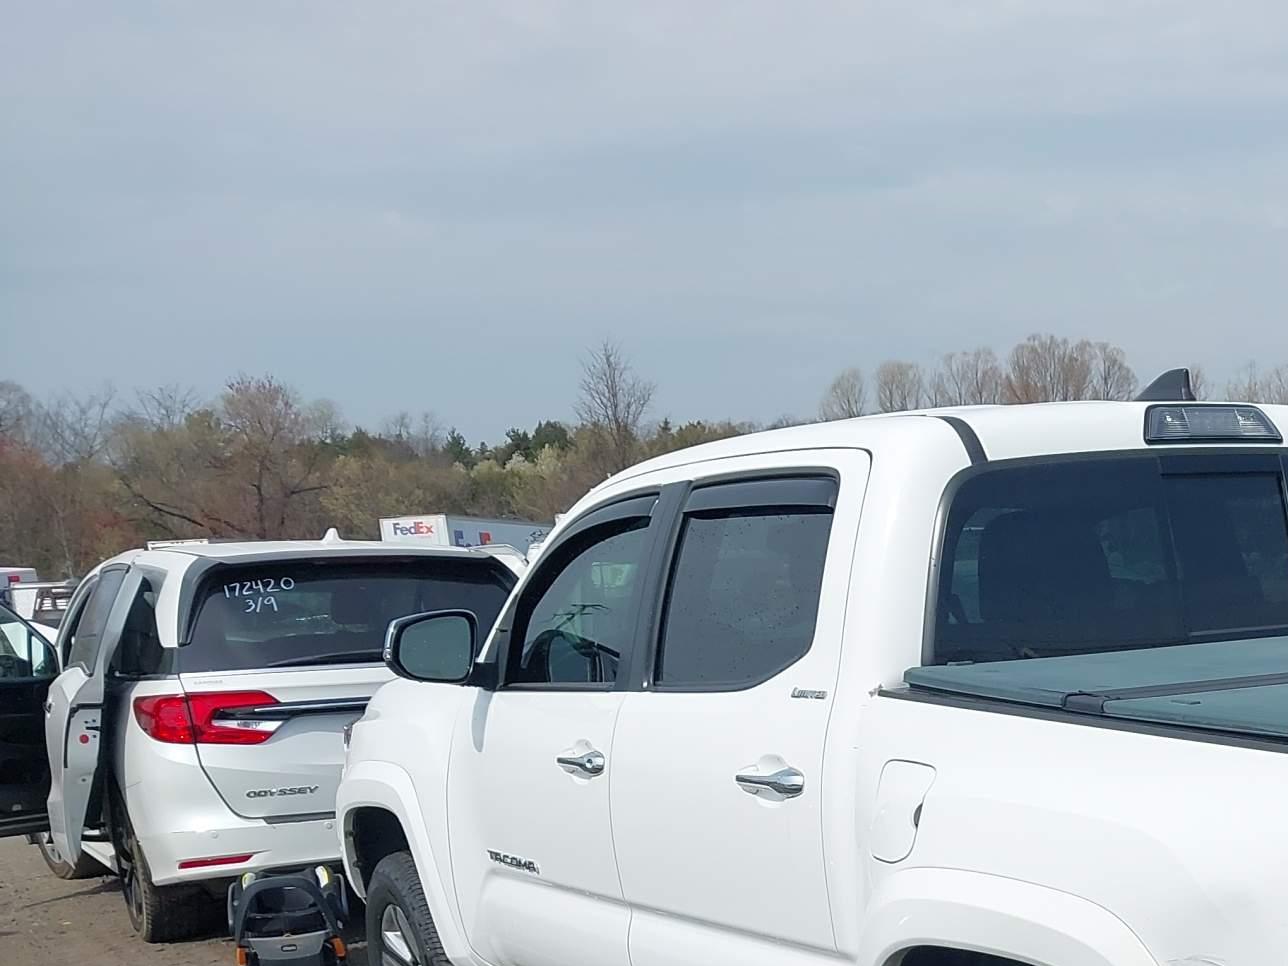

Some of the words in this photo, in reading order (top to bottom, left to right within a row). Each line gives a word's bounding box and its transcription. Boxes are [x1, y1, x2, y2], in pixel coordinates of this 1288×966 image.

[393, 521, 433, 536] FedEx
[223, 577, 295, 599] 172420
[245, 596, 279, 613] 3/9
[246, 785, 319, 799] ODYSSEY
[487, 848, 540, 875] TACOMA
